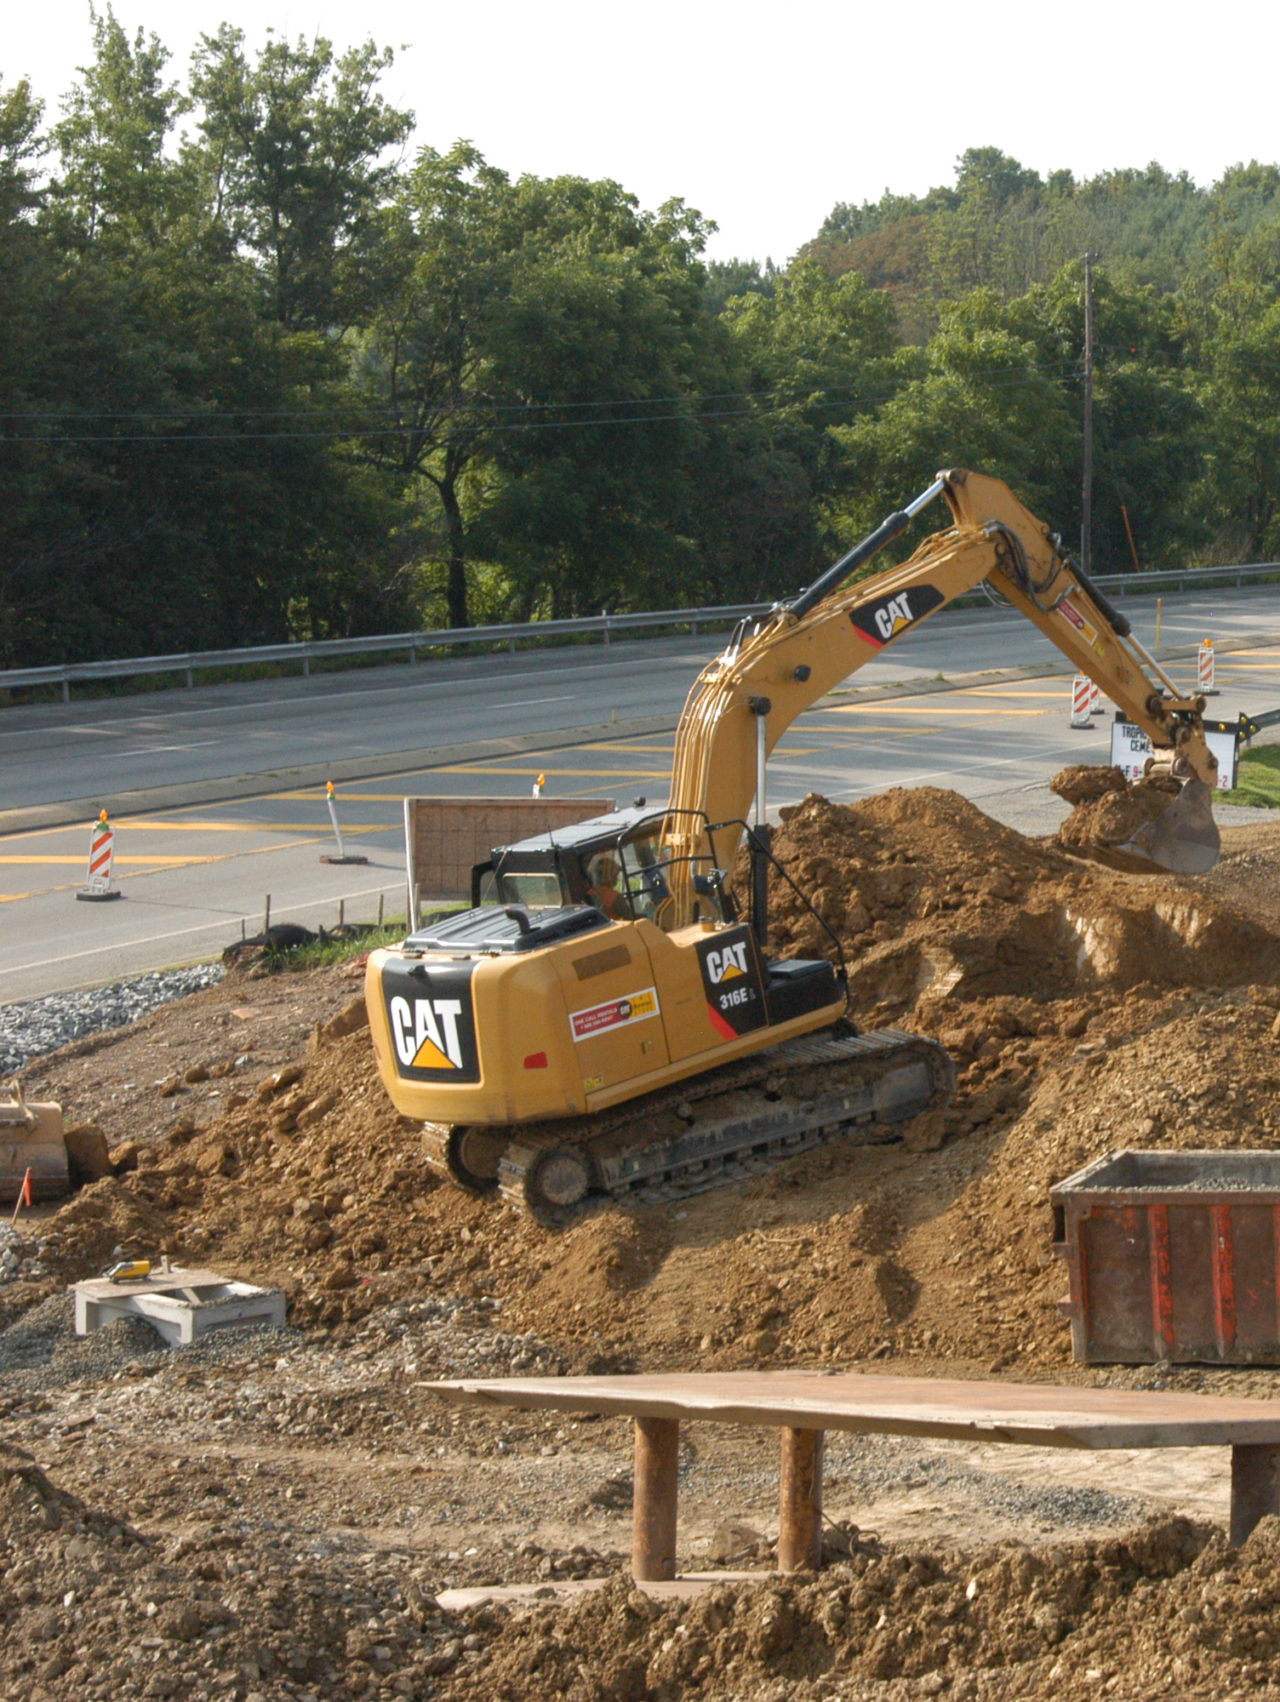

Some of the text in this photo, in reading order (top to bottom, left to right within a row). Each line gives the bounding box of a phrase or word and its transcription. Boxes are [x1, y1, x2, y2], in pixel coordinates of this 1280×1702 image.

[874, 592, 914, 639] CAT
[1130, 739, 1151, 753] CEME
[706, 941, 748, 985] CAT
[719, 988, 748, 1009] 316E
[390, 995, 464, 1069] CAT
